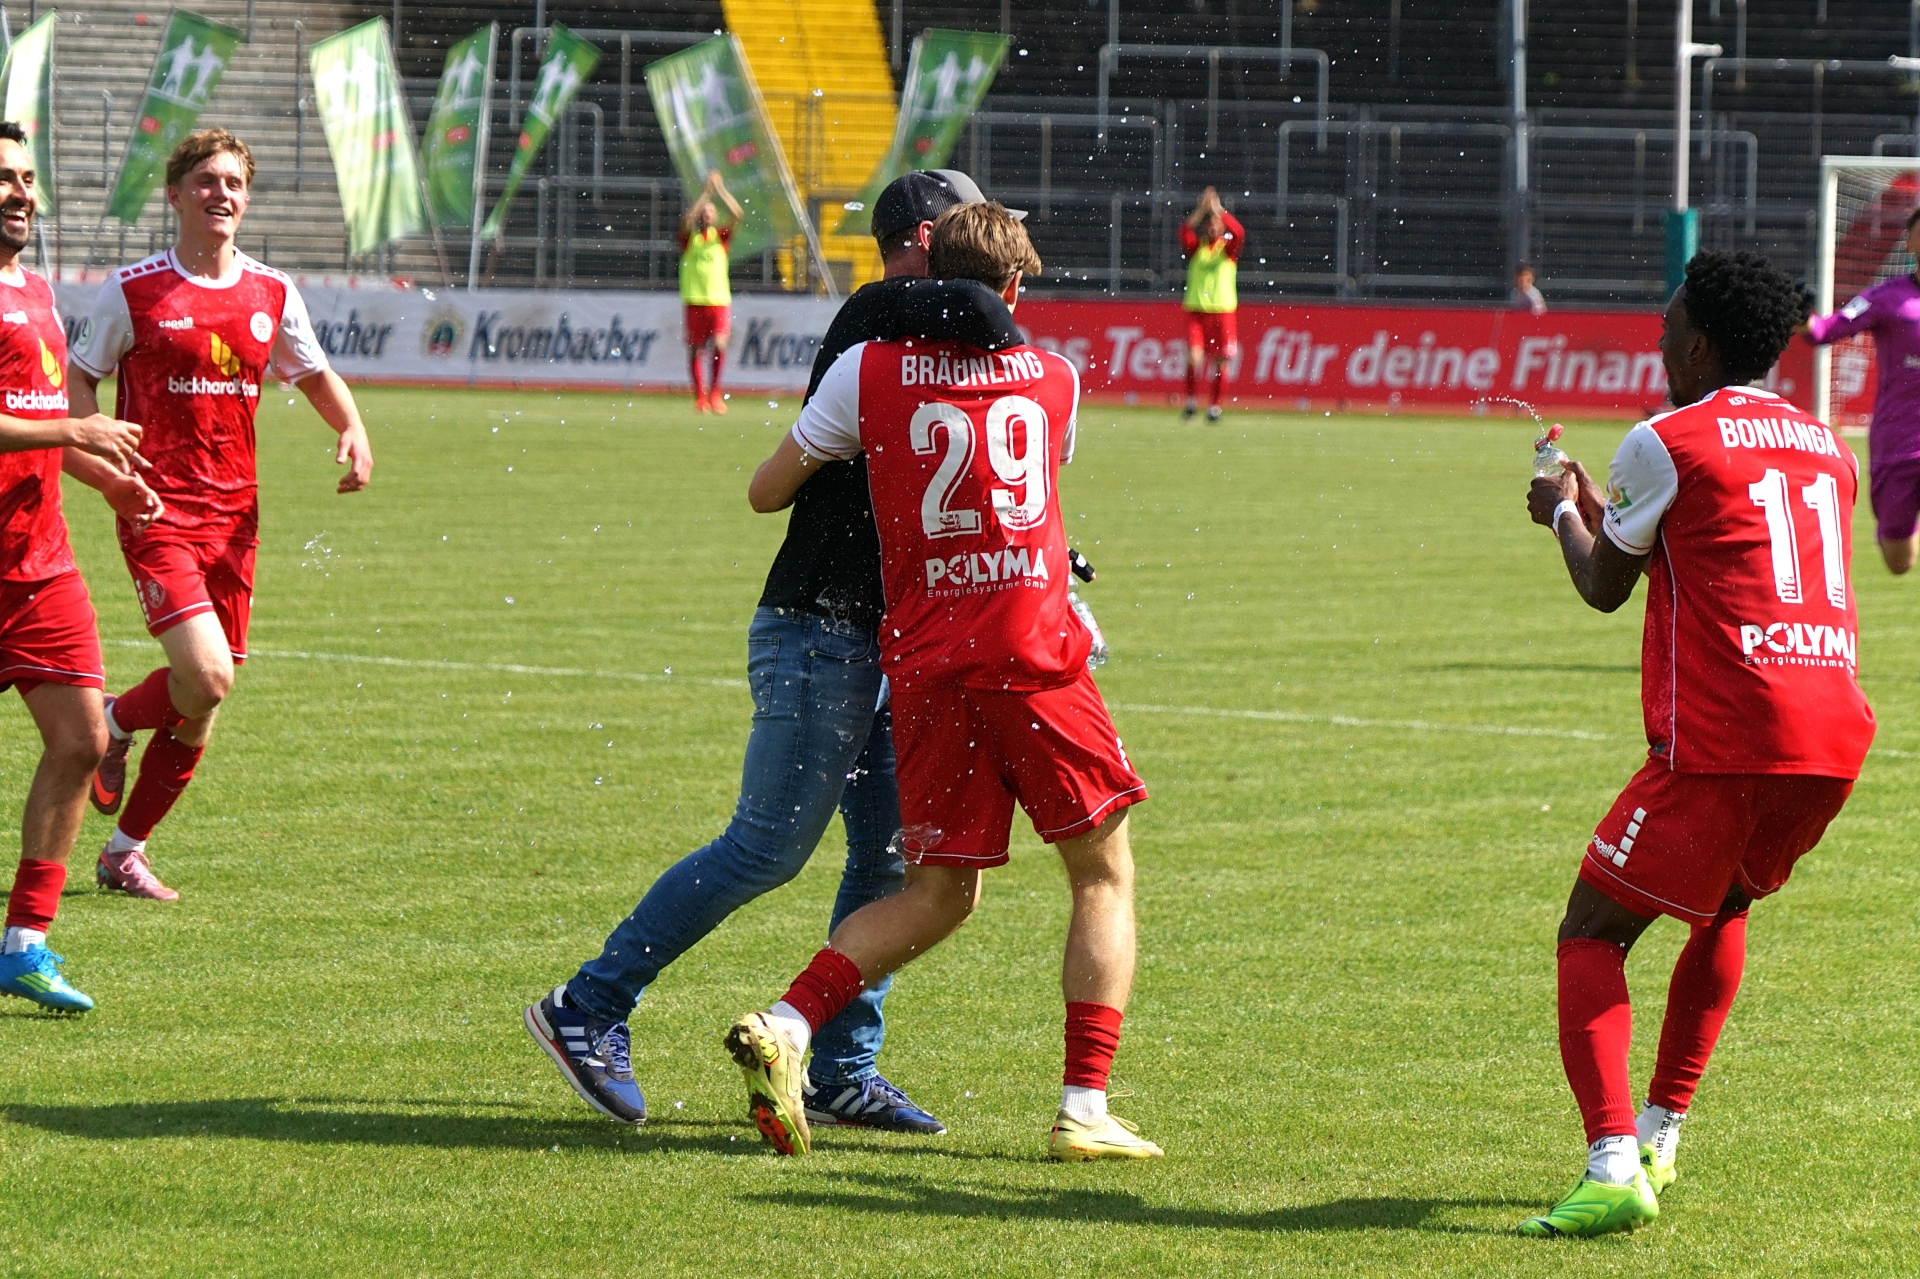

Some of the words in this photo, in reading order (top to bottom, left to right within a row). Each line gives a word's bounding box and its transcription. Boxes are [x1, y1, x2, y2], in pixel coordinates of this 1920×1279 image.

[312, 308, 393, 356] acher
[469, 309, 659, 362] Krombacher
[902, 351, 1044, 387] BRÄUNLING
[1254, 325, 1338, 384] für
[1346, 330, 1500, 389] deine
[1727, 395, 1747, 406] KSV
[1717, 417, 1842, 459] BONIANGA
[909, 395, 1050, 540] 29
[1748, 468, 1846, 611] 11
[925, 548, 1049, 588] POLYMA
[927, 581, 1020, 598] Energiesysteme
[1744, 655, 1844, 668] Energiesysteme
